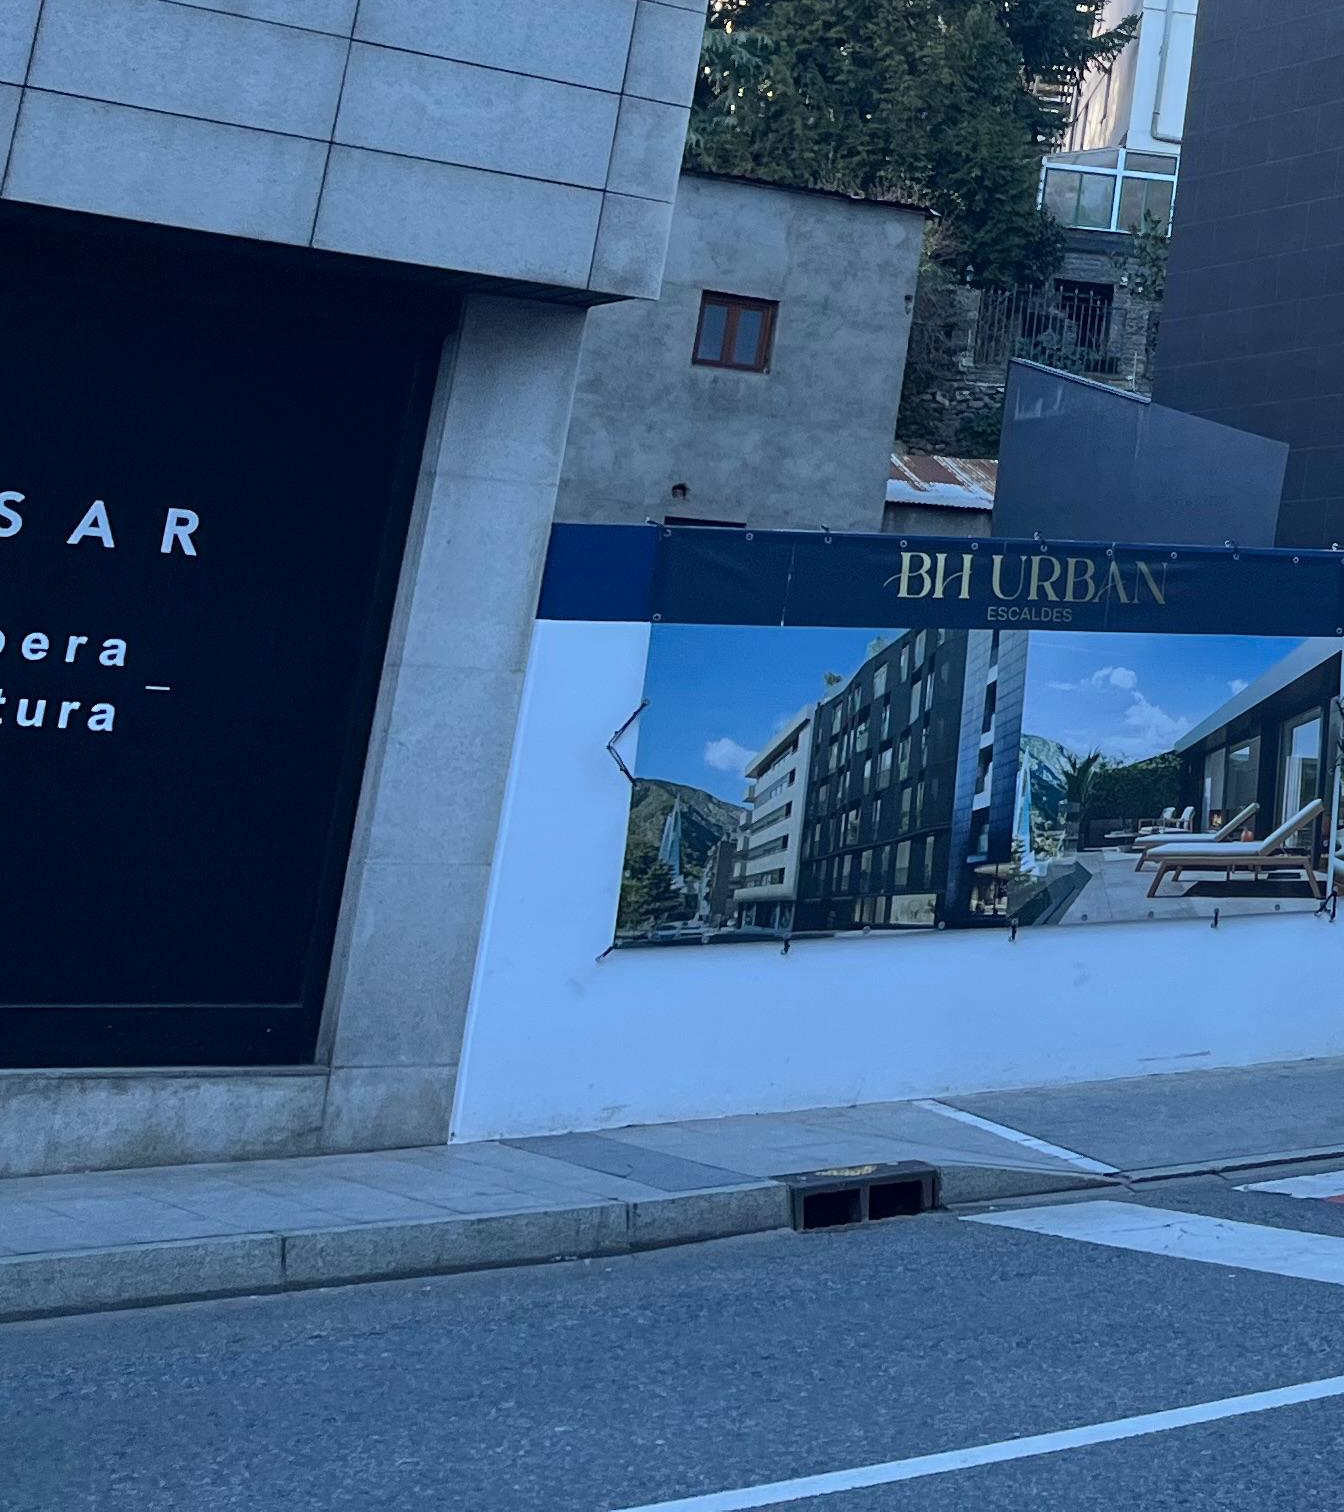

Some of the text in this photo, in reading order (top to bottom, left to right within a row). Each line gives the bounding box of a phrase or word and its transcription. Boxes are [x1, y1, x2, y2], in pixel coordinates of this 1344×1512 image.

[883, 551, 1168, 606] BH URBAN
[987, 606, 1073, 623] ESCALDES
[0, 629, 128, 667] era
